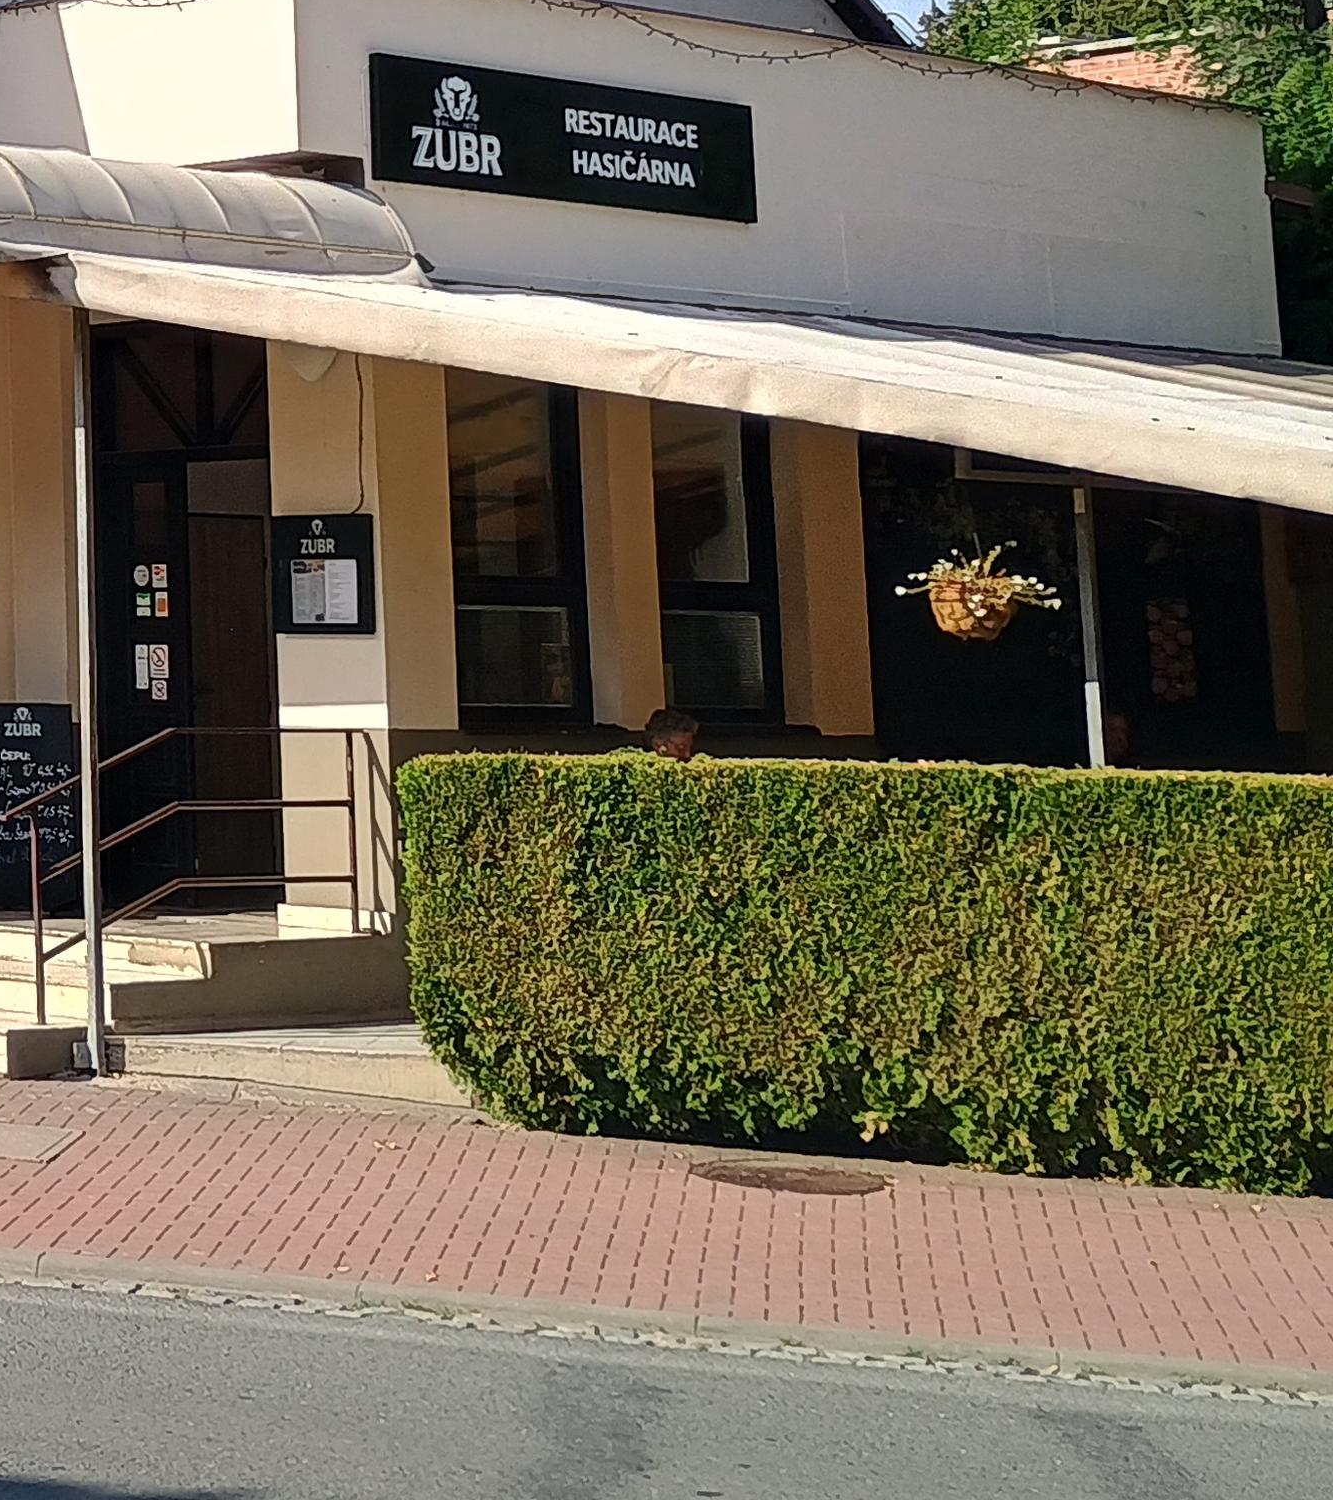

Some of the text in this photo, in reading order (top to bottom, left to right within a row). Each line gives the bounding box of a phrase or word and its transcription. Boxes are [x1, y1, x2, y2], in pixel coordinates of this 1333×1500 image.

[565, 108, 699, 149] RESTAURACE
[412, 125, 503, 176] ZUBR
[573, 150, 696, 188] HASIČÁRNA
[300, 538, 335, 554] ZUBR
[3, 723, 42, 737] ZUBR
